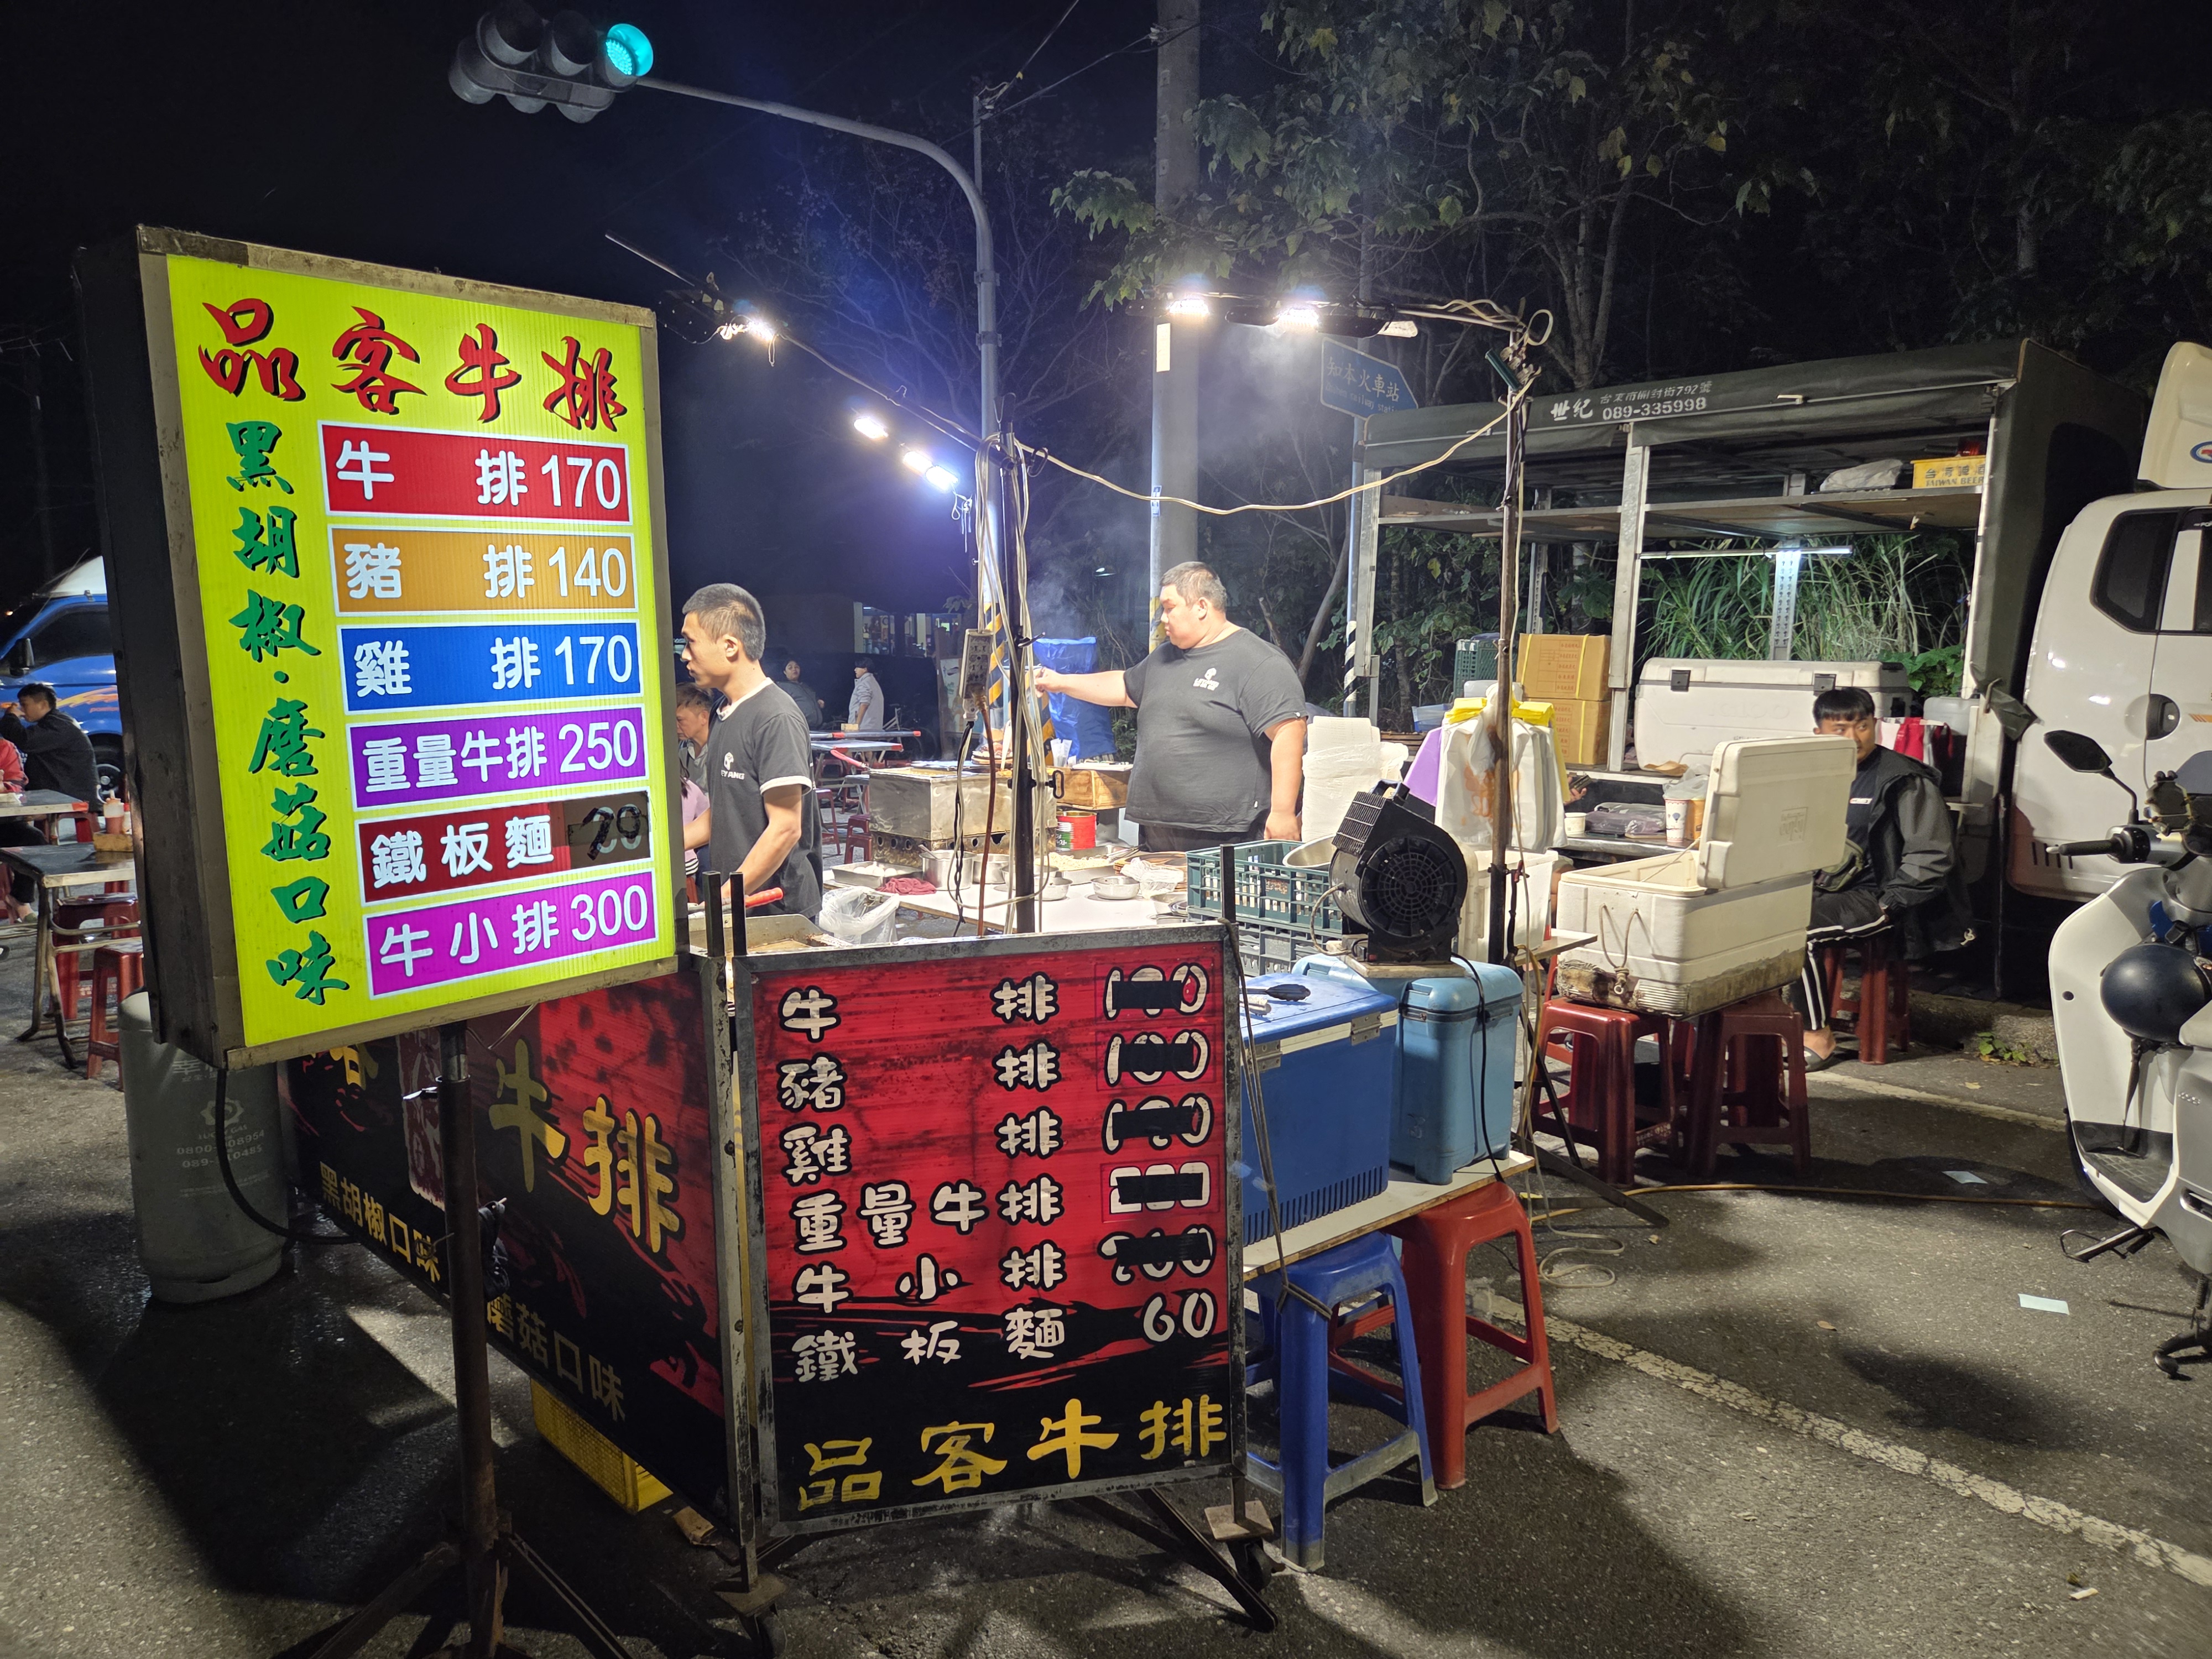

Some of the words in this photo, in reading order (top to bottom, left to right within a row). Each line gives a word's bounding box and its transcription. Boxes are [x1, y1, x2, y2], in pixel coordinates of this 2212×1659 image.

[198, 298, 628, 432] 品客牛排
[1327, 356, 1400, 402] 知本火車站
[1551, 398, 1593, 421] 世紀
[1602, 397, 1707, 420] 089-335998
[541, 452, 622, 510] 170
[1926, 478, 1957, 487] TAIWAN
[1960, 476, 1984, 485] BEER
[547, 546, 628, 598] 140
[554, 634, 633, 686] 170
[362, 726, 548, 793] 重量牛排
[558, 719, 639, 774] 250
[370, 815, 555, 888] 鐵板麵
[379, 898, 560, 977] 牛小排
[571, 884, 649, 942] 300
[320, 1161, 440, 1283] 黑胡椒口味
[791, 1173, 1063, 1254] 重量牛排
[794, 1240, 1066, 1314] 牛小排
[791, 1307, 1066, 1382] 鐵板麵
[1143, 1292, 1215, 1343] 60
[798, 1394, 1228, 1511] 品客牛排
